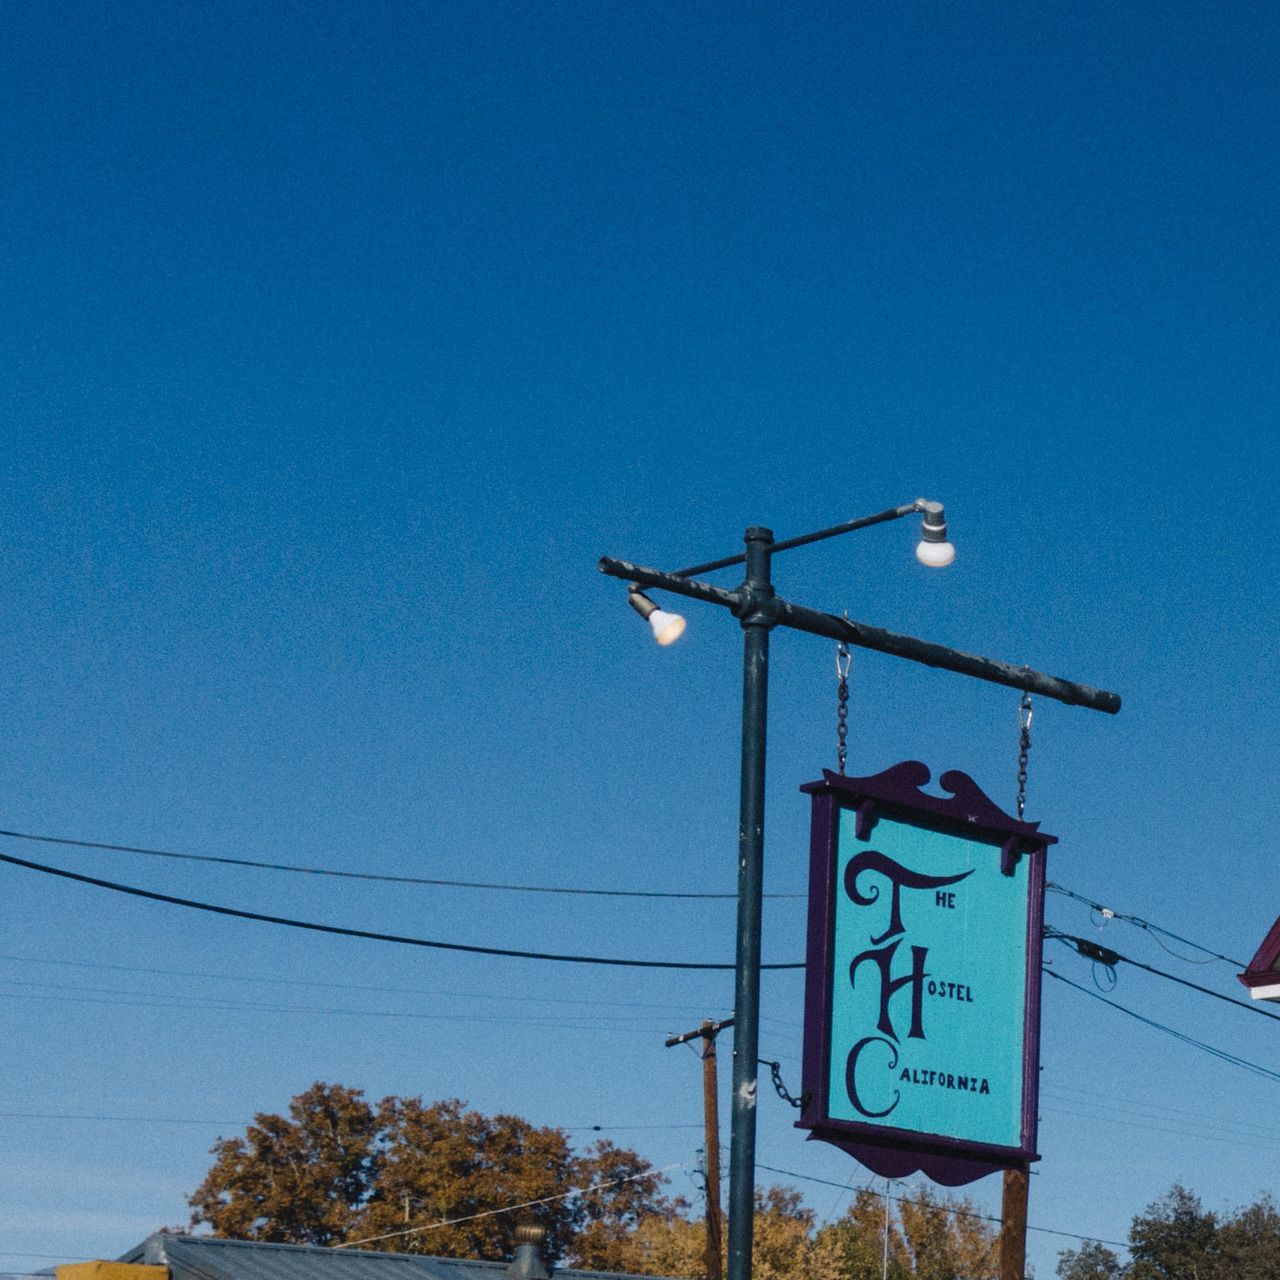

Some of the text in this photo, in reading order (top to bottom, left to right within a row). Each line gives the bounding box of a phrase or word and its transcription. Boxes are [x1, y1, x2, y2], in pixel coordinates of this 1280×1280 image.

[844, 851, 976, 944] THE
[849, 938, 973, 1044] HOSTEL
[845, 1037, 990, 1118] CALIFORNIA
